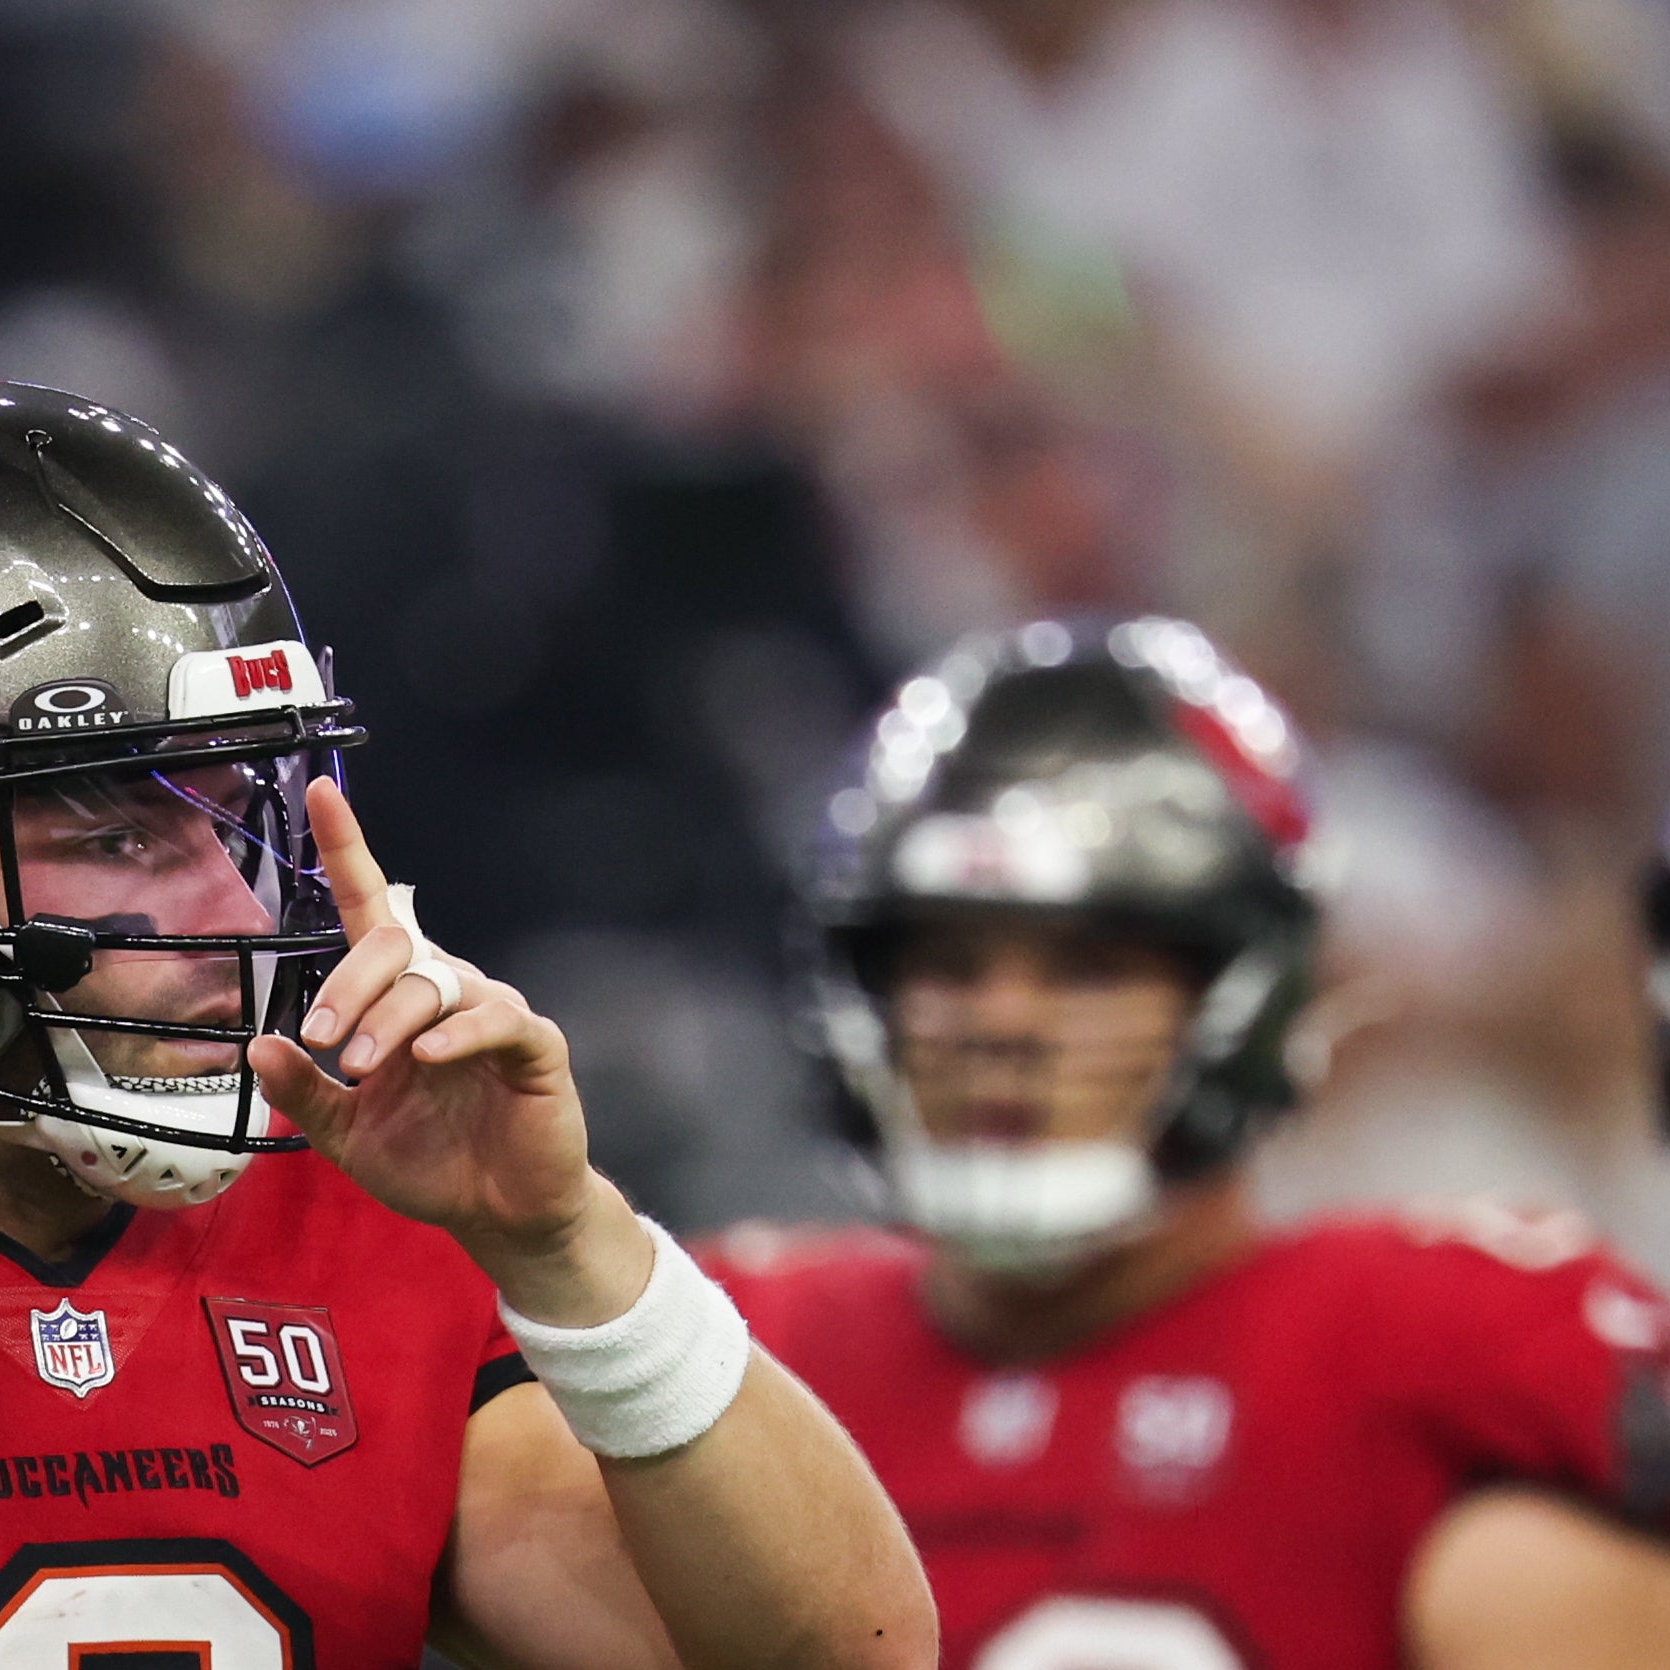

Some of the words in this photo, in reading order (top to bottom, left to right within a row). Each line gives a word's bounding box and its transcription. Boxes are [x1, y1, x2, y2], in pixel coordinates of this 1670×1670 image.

[17, 709, 127, 731] OAKLEY
[47, 1343, 103, 1379] NFL
[225, 1317, 331, 1395] 50
[259, 1395, 326, 1413] SEASONS
